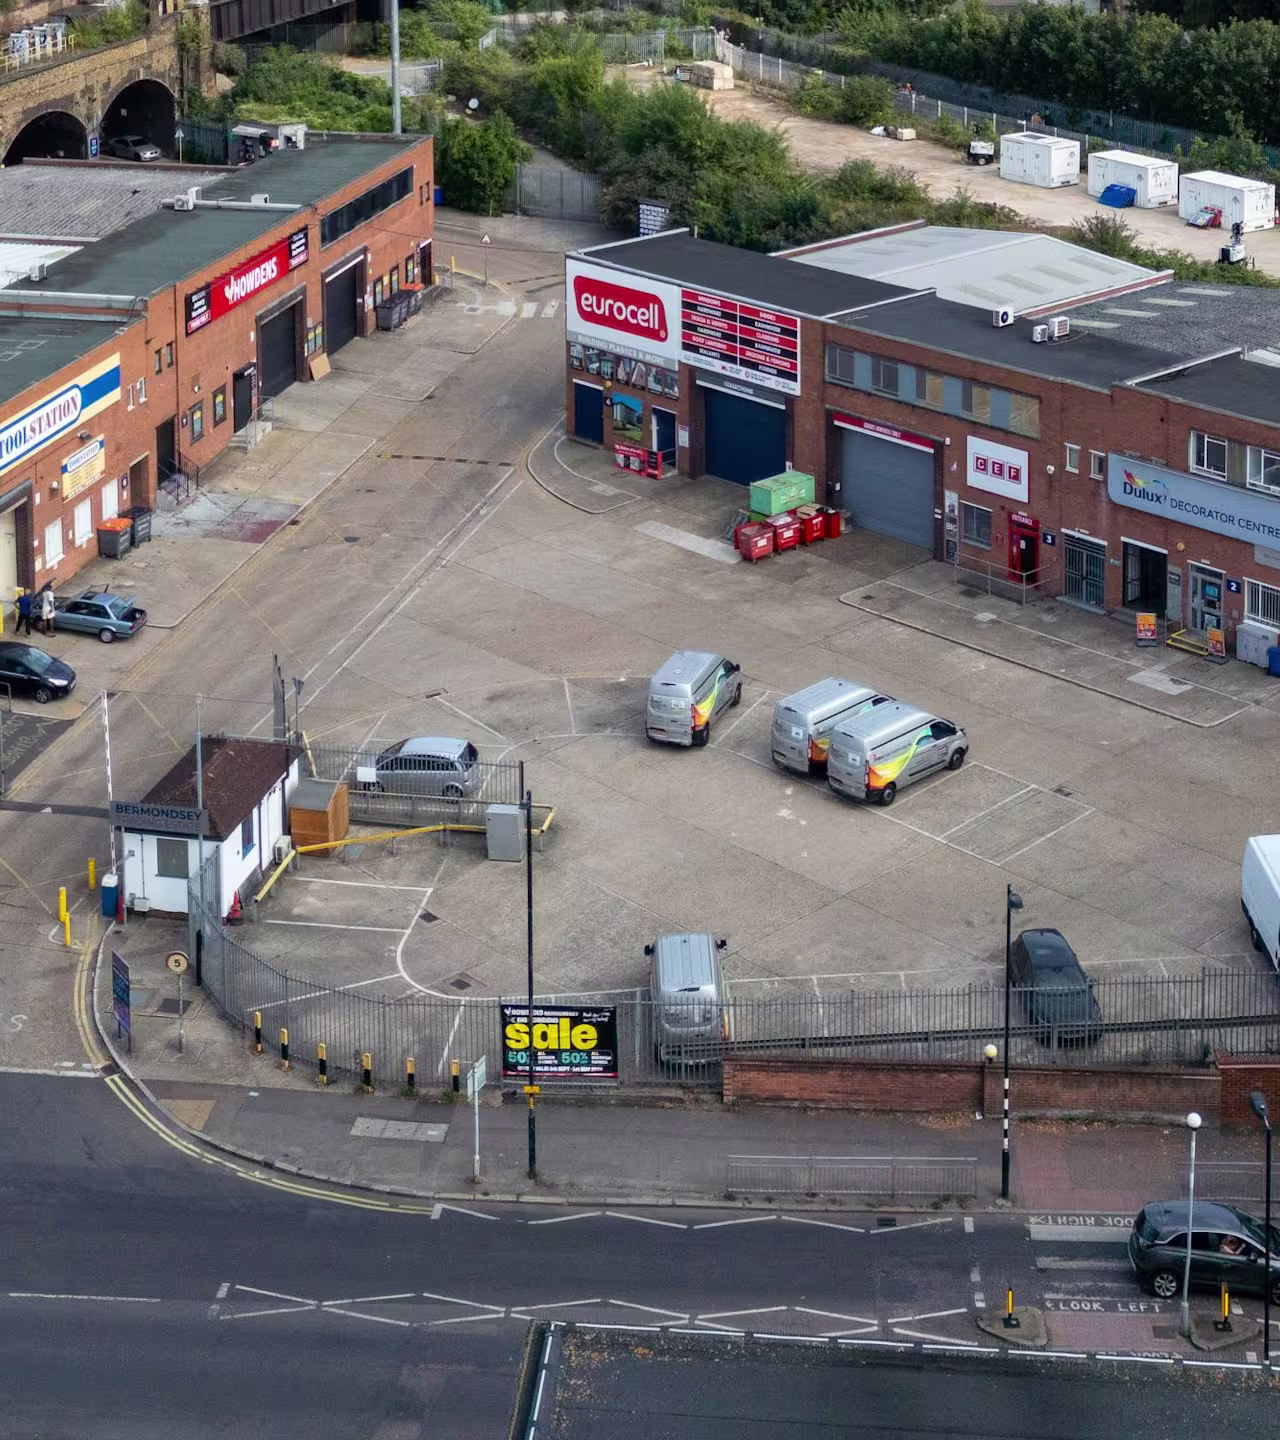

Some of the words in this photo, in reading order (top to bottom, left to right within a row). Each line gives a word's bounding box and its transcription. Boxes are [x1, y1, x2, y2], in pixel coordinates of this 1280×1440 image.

[233, 256, 277, 301] HOWDENS
[580, 293, 659, 330] eurocell
[723, 381, 754, 395] COLLECTIONS
[1123, 481, 1162, 505] Dulux
[1170, 498, 1235, 527] DECORATOR
[1011, 514, 1033, 526] ENTRANCE
[1046, 535, 1052, 543] 3
[1231, 582, 1237, 591] 2
[115, 803, 202, 821] BERMONDSEY
[174, 959, 181, 968] 5
[504, 1017, 598, 1050] sale
[561, 1051, 589, 1064] 50%
[1043, 1215, 1095, 1226] RIGHT
[1102, 1216, 1135, 1227] OOK
[1059, 1300, 1106, 1312] LOOK
[1118, 1302, 1163, 1313] LEFT
